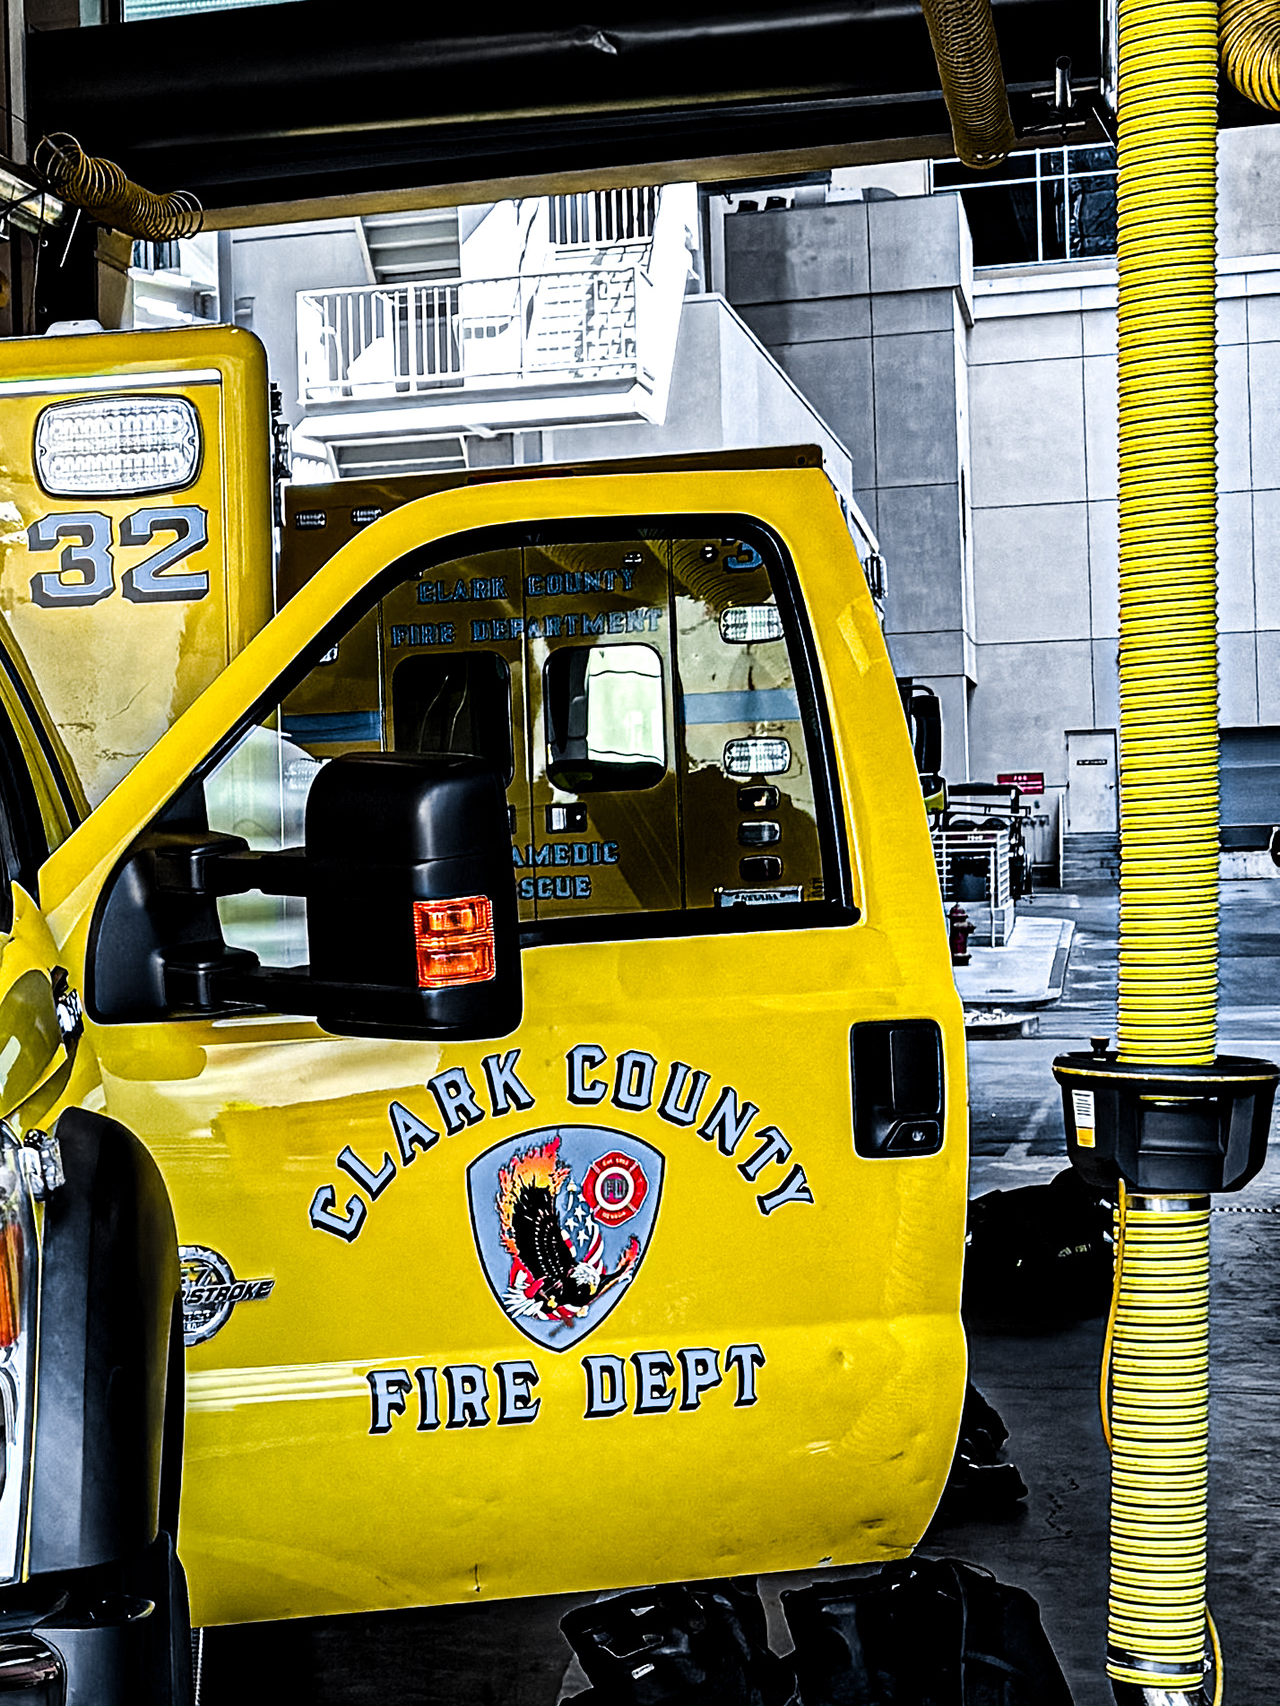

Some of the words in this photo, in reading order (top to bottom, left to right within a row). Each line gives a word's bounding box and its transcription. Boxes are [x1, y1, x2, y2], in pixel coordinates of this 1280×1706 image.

[26, 504, 209, 608] 32
[415, 574, 510, 605] CLARK
[526, 567, 637, 598] COUNTY
[390, 622, 457, 648] FIRE
[470, 607, 663, 644] DEPARTMENT
[510, 840, 621, 869] AMEDIC
[518, 875, 592, 901] SCUE
[309, 1048, 536, 1243] CLARK
[565, 1043, 814, 1216] COUNTY
[182, 1280, 275, 1305] STROKE
[367, 1360, 541, 1435] FIRE
[581, 1343, 767, 1419] DEPT
